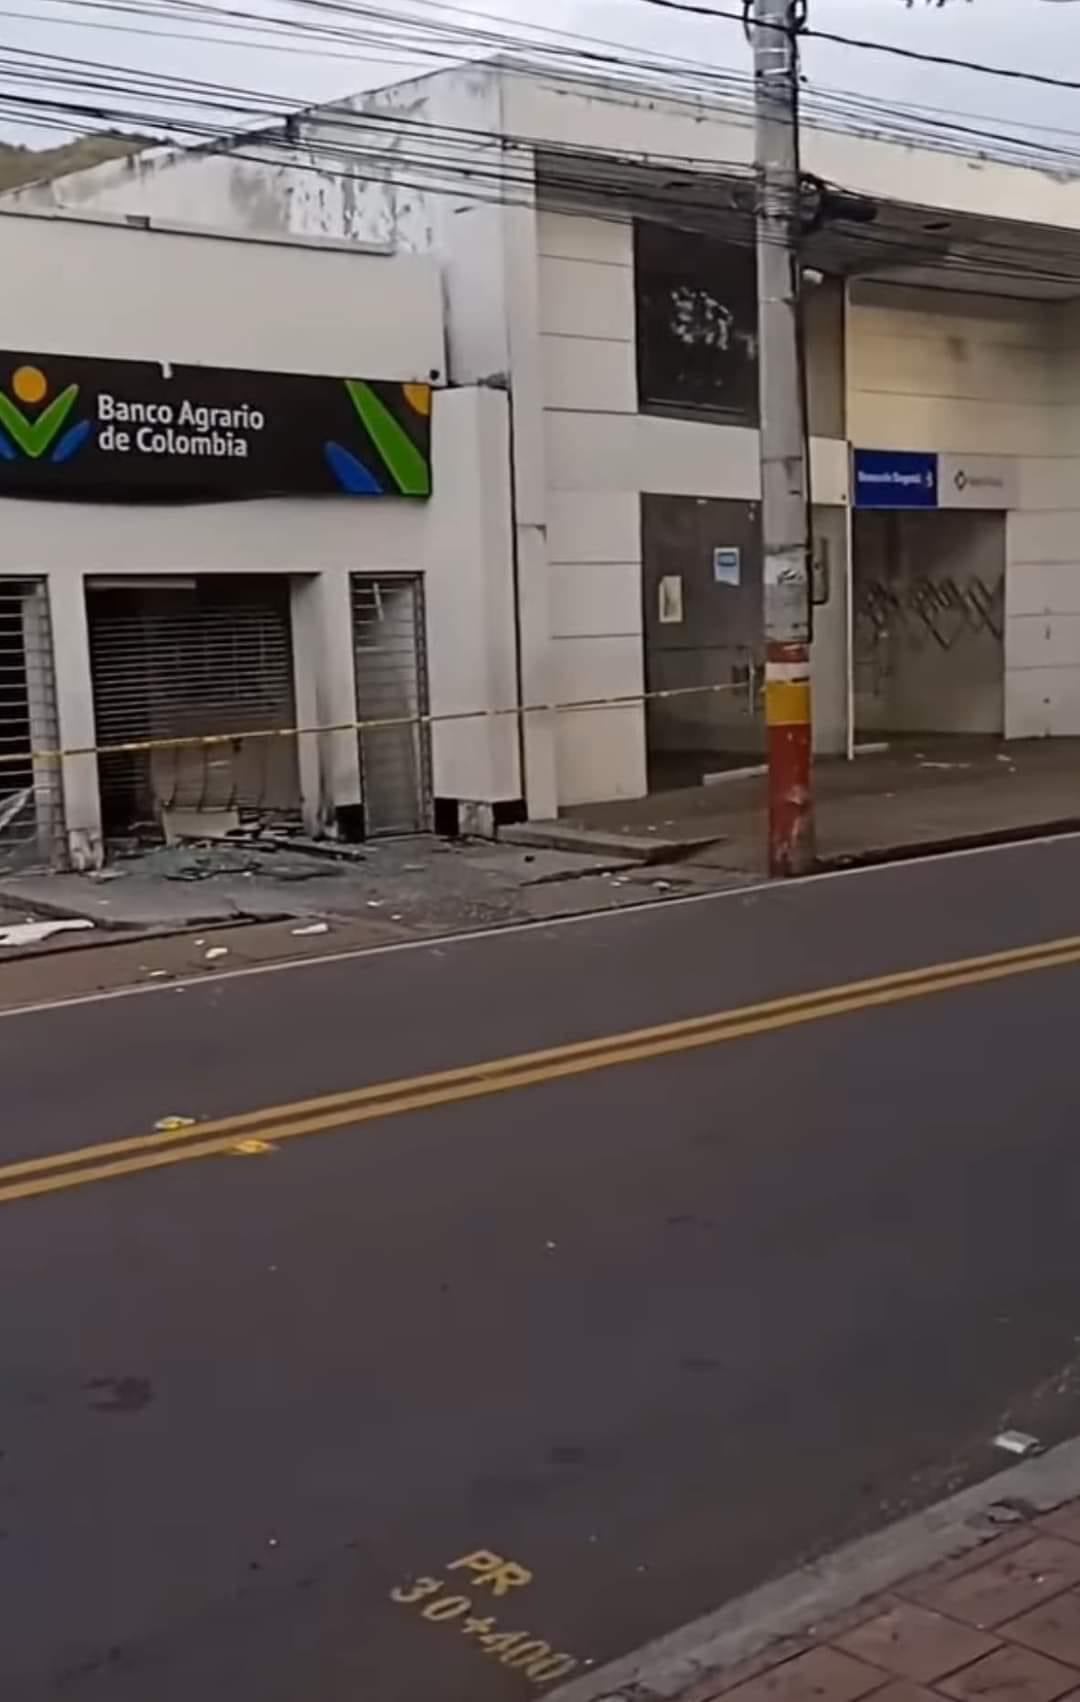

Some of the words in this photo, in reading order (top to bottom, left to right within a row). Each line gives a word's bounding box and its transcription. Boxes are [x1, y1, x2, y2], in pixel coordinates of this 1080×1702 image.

[97, 394, 173, 423] Banco
[178, 400, 265, 430] Agrario
[99, 425, 130, 450] de
[136, 427, 248, 457] Colombia
[446, 1549, 533, 1596] PR
